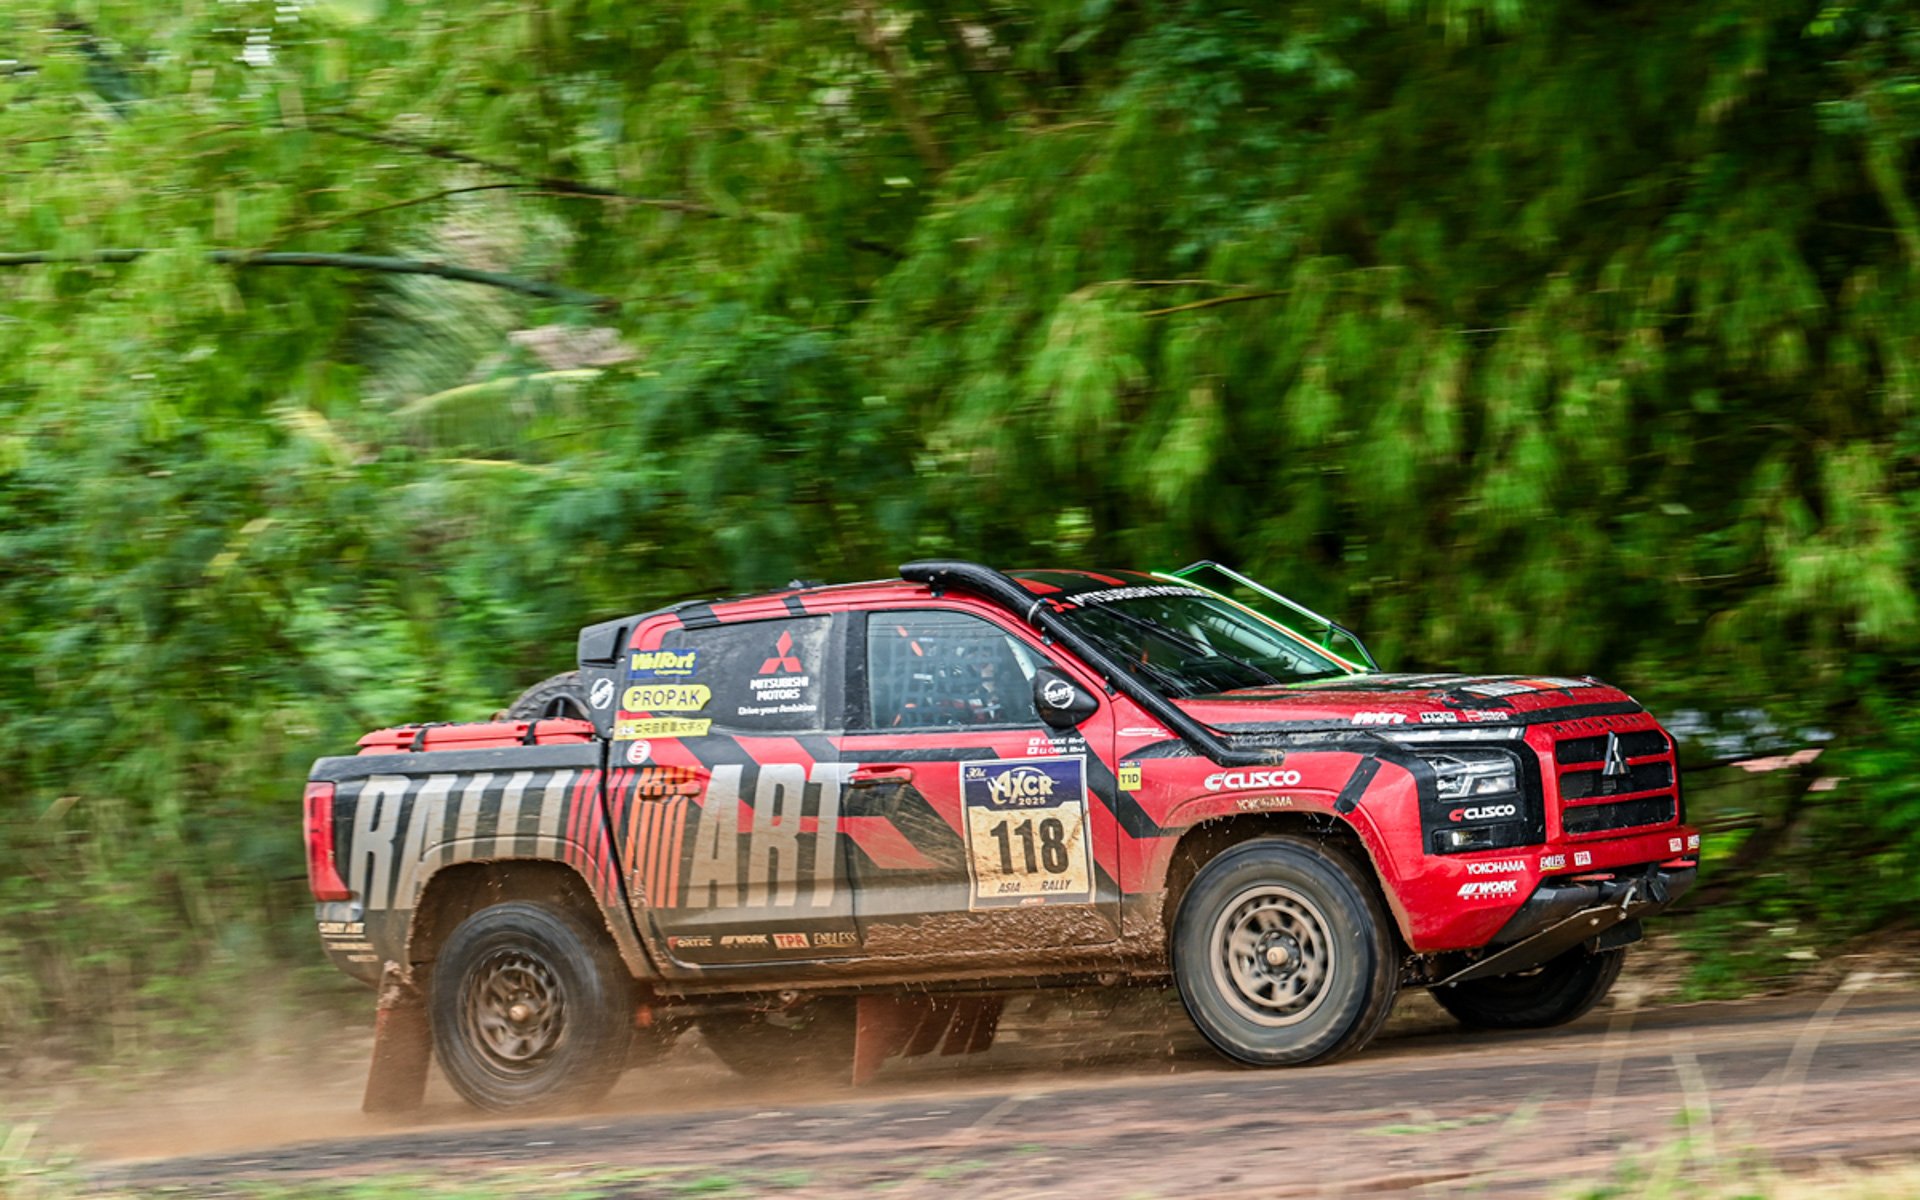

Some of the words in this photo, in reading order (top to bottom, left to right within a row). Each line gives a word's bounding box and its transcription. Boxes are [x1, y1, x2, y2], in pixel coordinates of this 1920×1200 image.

[750, 676, 809, 690] MITSUBISHI
[631, 689, 700, 706] PROPAK
[757, 689, 801, 701] MOTORS
[1120, 773, 1140, 784] T1D
[1019, 797, 1046, 806] 2025
[990, 818, 1069, 875] 118
[1466, 861, 1527, 875] YOKOHAMA
[998, 882, 1021, 894] ASIA
[1040, 879, 1072, 892] RALLY
[1478, 880, 1518, 893] WORK
[775, 934, 807, 948] TPR
[814, 931, 857, 945] ENDLESS
